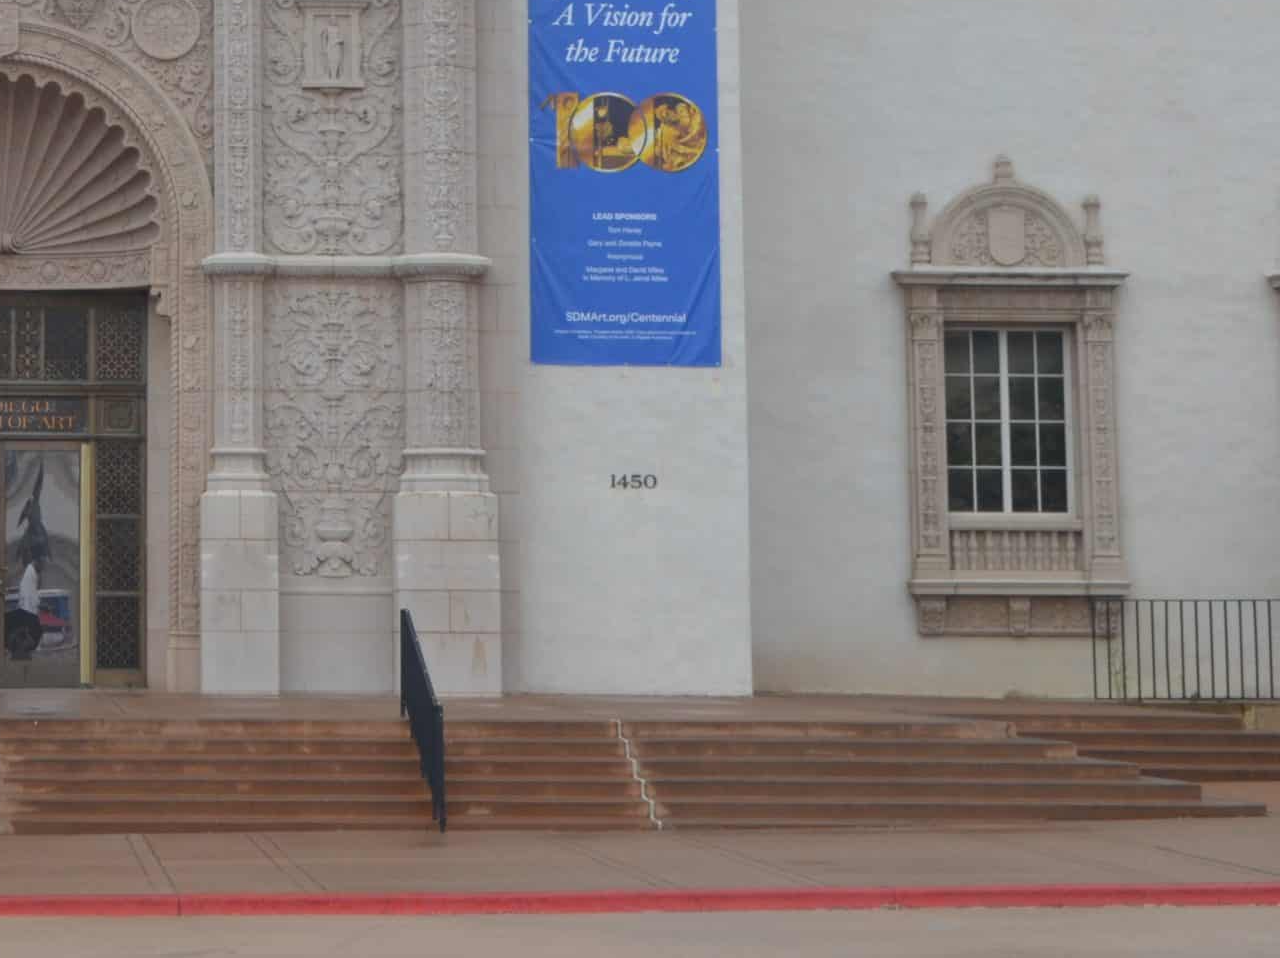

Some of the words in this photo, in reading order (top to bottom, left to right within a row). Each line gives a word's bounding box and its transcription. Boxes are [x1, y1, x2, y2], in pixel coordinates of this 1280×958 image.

[552, 3, 575, 26] A
[584, 2, 653, 27] Vision
[652, 3, 692, 35] for
[565, 39, 598, 63] the
[604, 39, 680, 64] Future
[566, 311, 687, 324] SDMArt.org/Centennial
[7, 414, 35, 429] OF
[37, 414, 77, 430] ART
[609, 473, 657, 489] 1450
